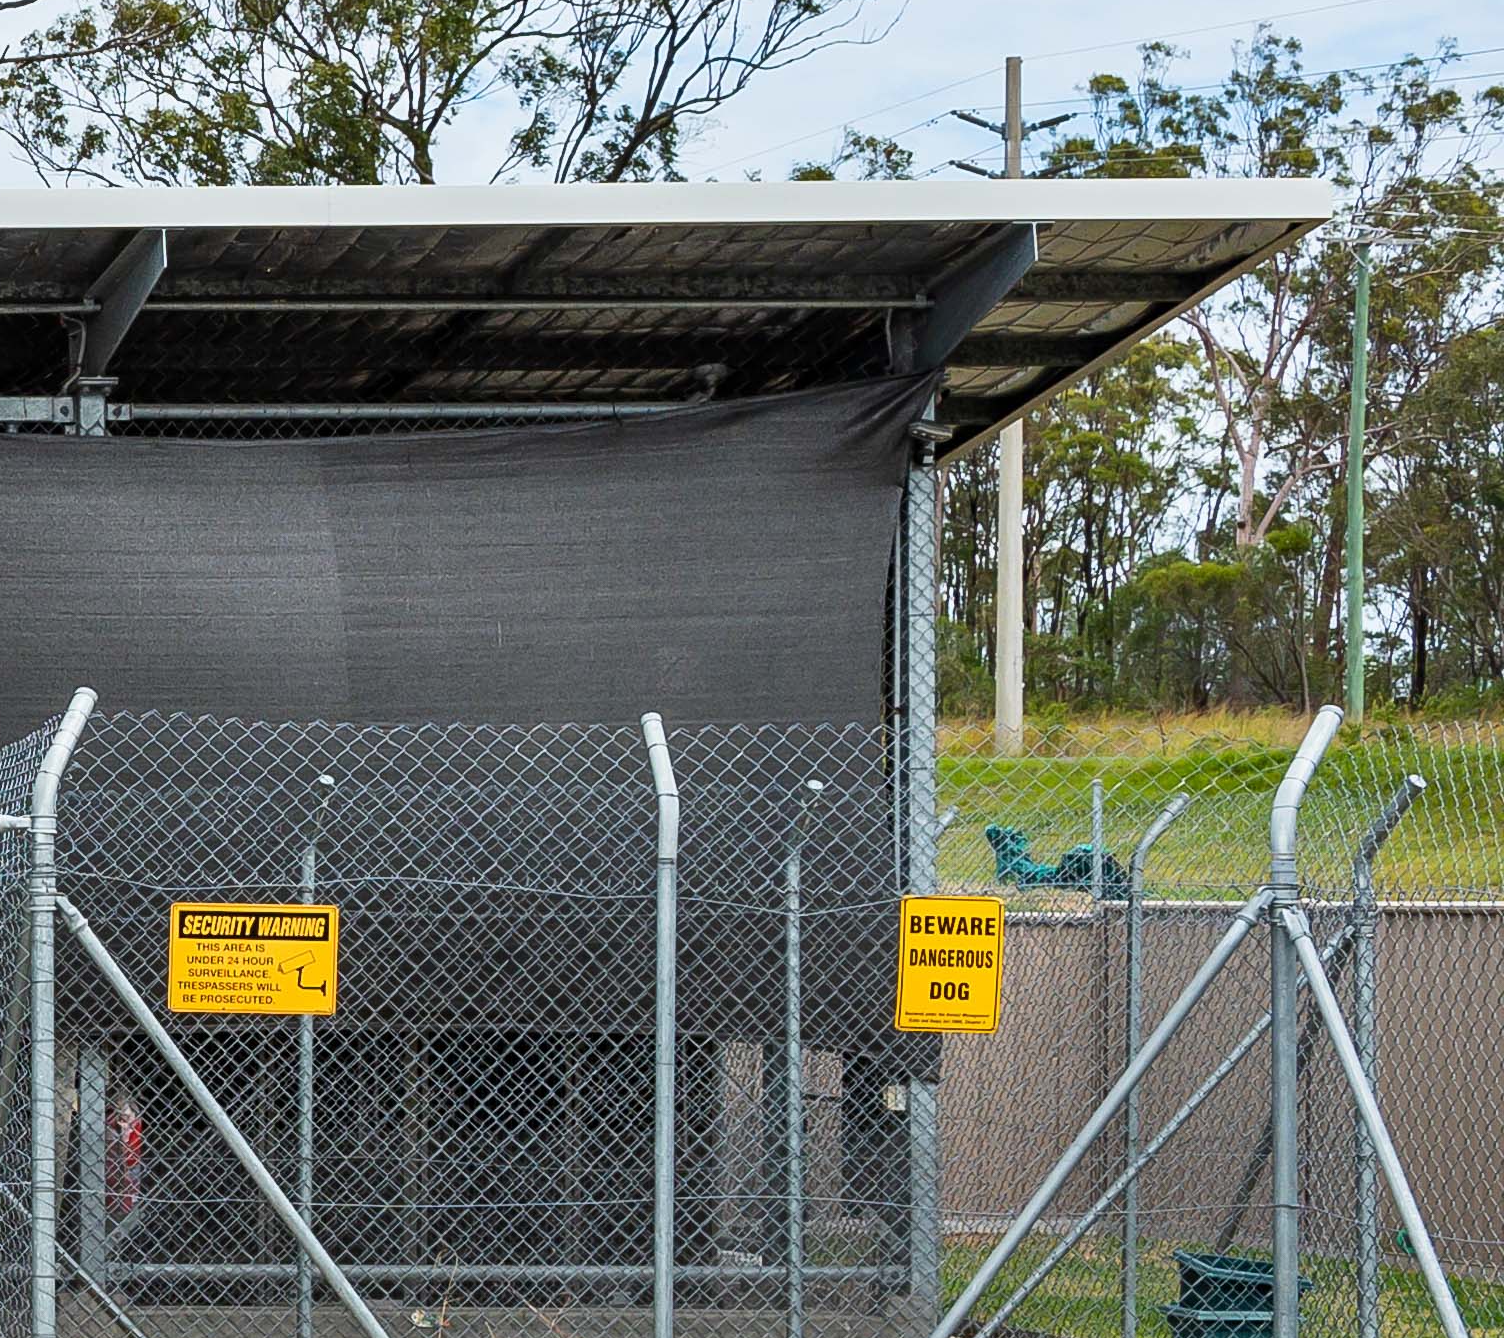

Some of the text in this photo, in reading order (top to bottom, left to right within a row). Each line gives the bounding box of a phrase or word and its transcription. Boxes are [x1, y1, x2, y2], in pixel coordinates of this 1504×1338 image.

[182, 915, 326, 938] SECURITY WARNING
[910, 915, 996, 936] BEWARE
[196, 942, 265, 952] THIS AREA IS
[187, 956, 274, 966] UNDER 24 HOUR
[909, 948, 993, 969] DANGEROUS
[188, 969, 271, 979] SURVEILLANCE.
[177, 981, 282, 992] TRESPASSERS WILL
[929, 981, 970, 1001] DOG
[182, 994, 276, 1005] BE PROSECUTED.
